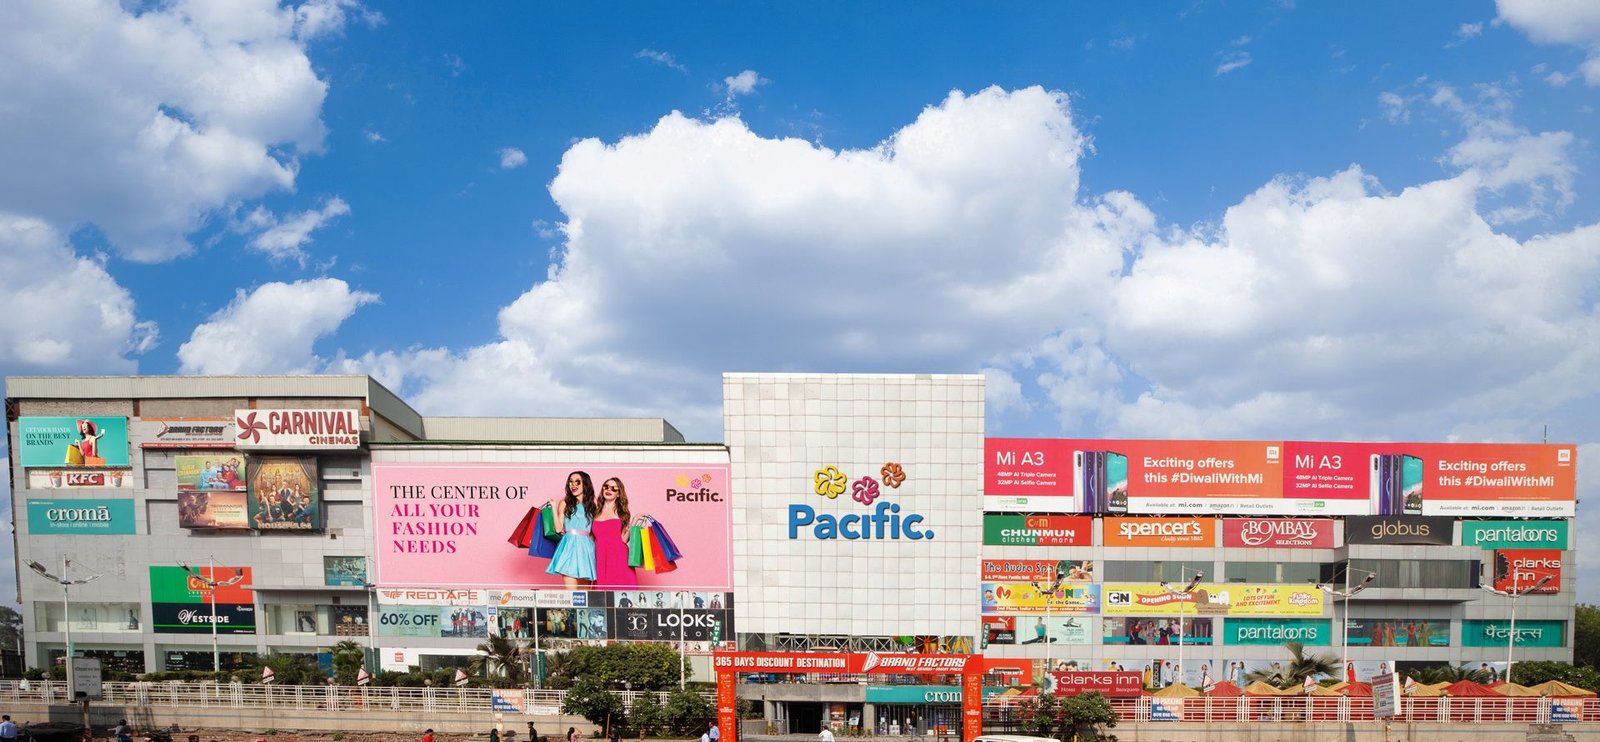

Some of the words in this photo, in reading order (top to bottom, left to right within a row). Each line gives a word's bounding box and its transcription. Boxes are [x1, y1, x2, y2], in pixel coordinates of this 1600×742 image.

[268, 411, 358, 435] CARNIVAL
[309, 436, 358, 445] CINEMAS
[996, 451, 1016, 466] Mi
[1021, 451, 1045, 466] A3
[1143, 456, 1194, 470] Exciting
[1197, 458, 1235, 469] offers
[1295, 454, 1314, 469] Mi
[1319, 455, 1342, 470] A3
[1438, 460, 1487, 474] Exciting
[1490, 461, 1527, 472] offers
[68, 473, 99, 484] KFC
[1144, 473, 1168, 483] this
[1171, 473, 1263, 484] #DiwaliWithMi
[1439, 476, 1461, 486] this
[1464, 476, 1554, 487] #DiwaliWithMi
[390, 486, 425, 499] THE
[431, 486, 500, 499] CENTER
[505, 486, 528, 500] OF
[391, 504, 425, 517] ALL
[430, 504, 480, 517] YOUR
[392, 522, 477, 535] FASHION
[1001, 529, 1075, 537] CHUNMUN
[1120, 521, 1201, 540] spencer's
[1241, 520, 1318, 541] BOMBAY
[1371, 520, 1430, 539] globus
[1475, 526, 1558, 544] pantaloons
[393, 540, 457, 554] NEEDS
[984, 562, 1001, 573] The
[1003, 562, 1033, 573] Rudra
[1513, 557, 1561, 569] clarks
[1109, 593, 1130, 603] CN
[1141, 595, 1171, 604] OPENING
[380, 613, 410, 625] 60%
[413, 615, 438, 625] OFF
[657, 613, 715, 627] LOOKS
[711, 620, 721, 647] ENTRY
[981, 624, 990, 649] ENTRY
[1238, 624, 1317, 642] pantaloons
[716, 656, 732, 667] 365
[734, 656, 755, 667] DAYS
[757, 657, 794, 668] DISCOUNT
[796, 658, 846, 668] DESTINATION
[880, 657, 915, 667] BRAND
[918, 658, 966, 667] FACTORY
[1060, 674, 1112, 685] clarks
[1116, 674, 1140, 685] inn
[925, 691, 962, 702] crom
